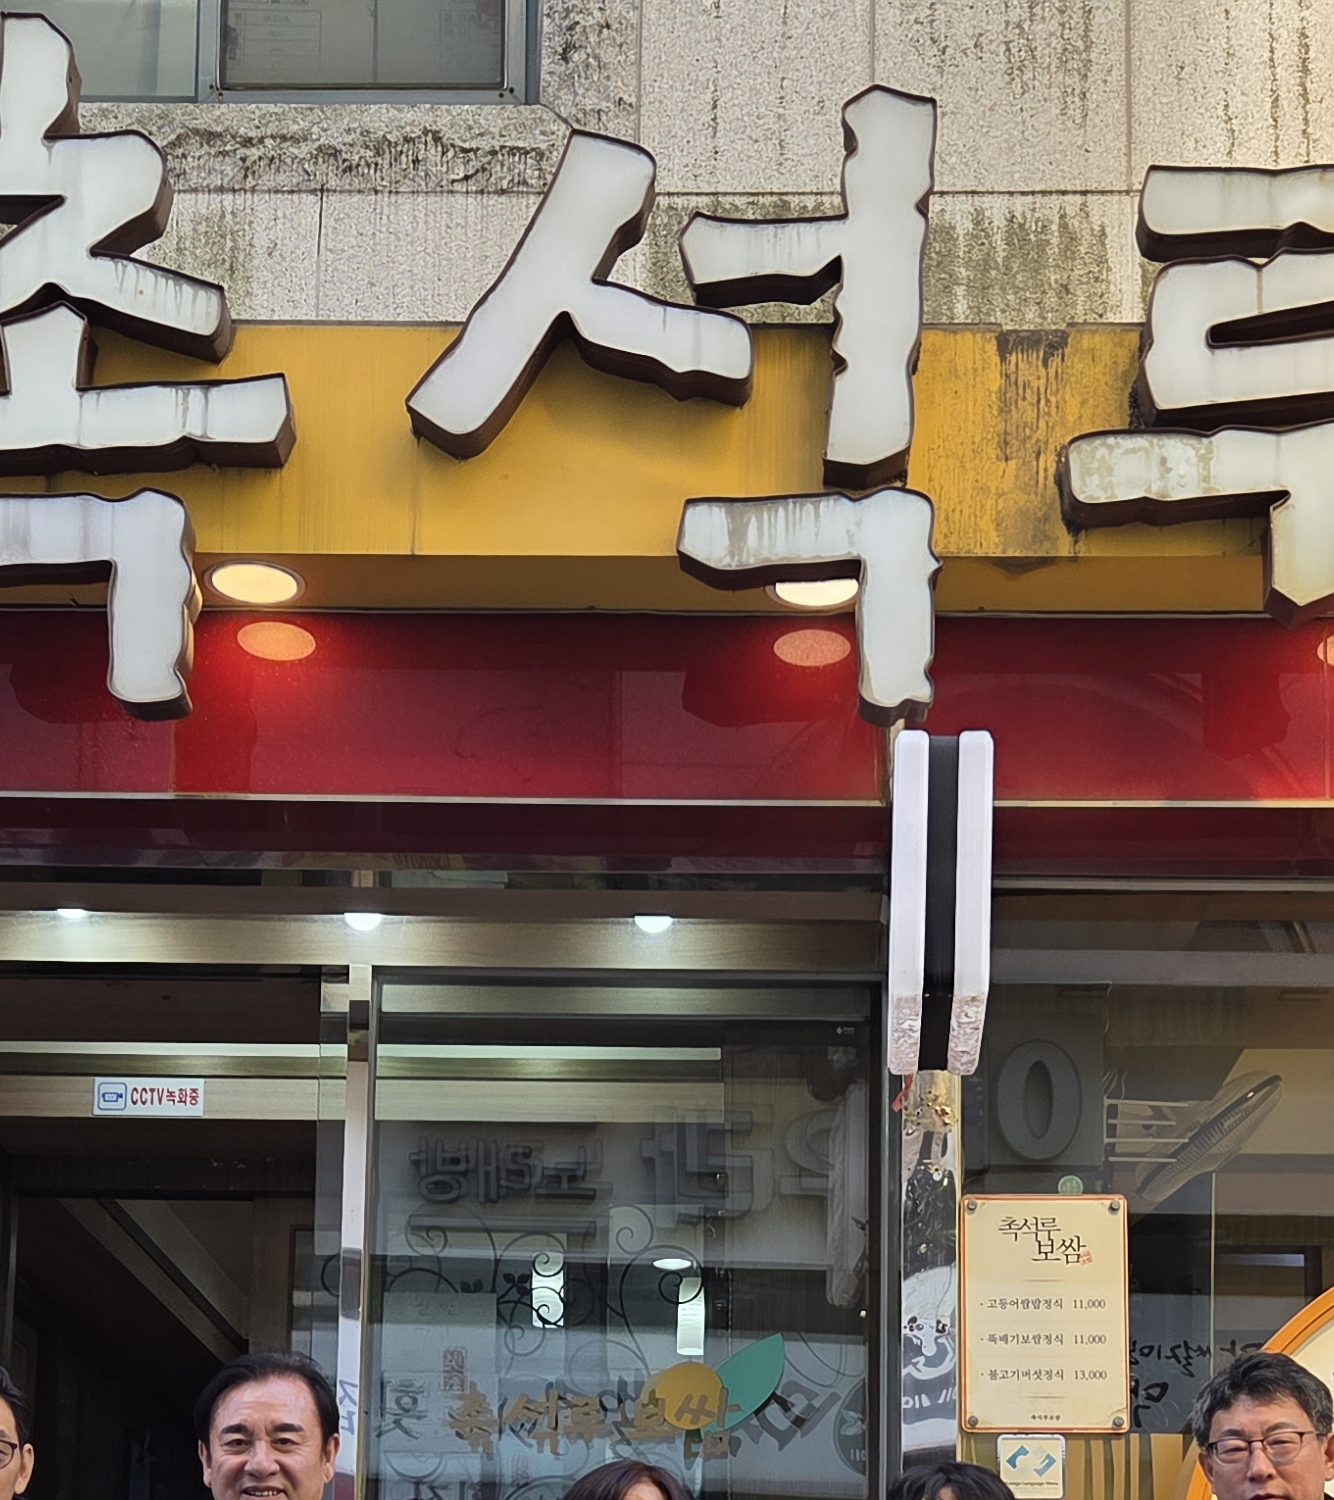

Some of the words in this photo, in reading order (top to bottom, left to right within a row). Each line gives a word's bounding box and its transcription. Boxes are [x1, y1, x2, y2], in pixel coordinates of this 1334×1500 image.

[130, 1086, 201, 1107] CCTV녹화중
[998, 1216, 1061, 1242] 촉석루
[1031, 1235, 1087, 1265] 보쌈
[986, 1298, 1064, 1310] 고등어쌈밥정식
[1073, 1299, 1106, 1310] 11,000
[987, 1333, 1064, 1346] 뚝배기보쌈정식
[1073, 1334, 1107, 1345] 11,000
[987, 1368, 1065, 1381] 불고기버섯정식
[1073, 1370, 1108, 1381] 13,000
